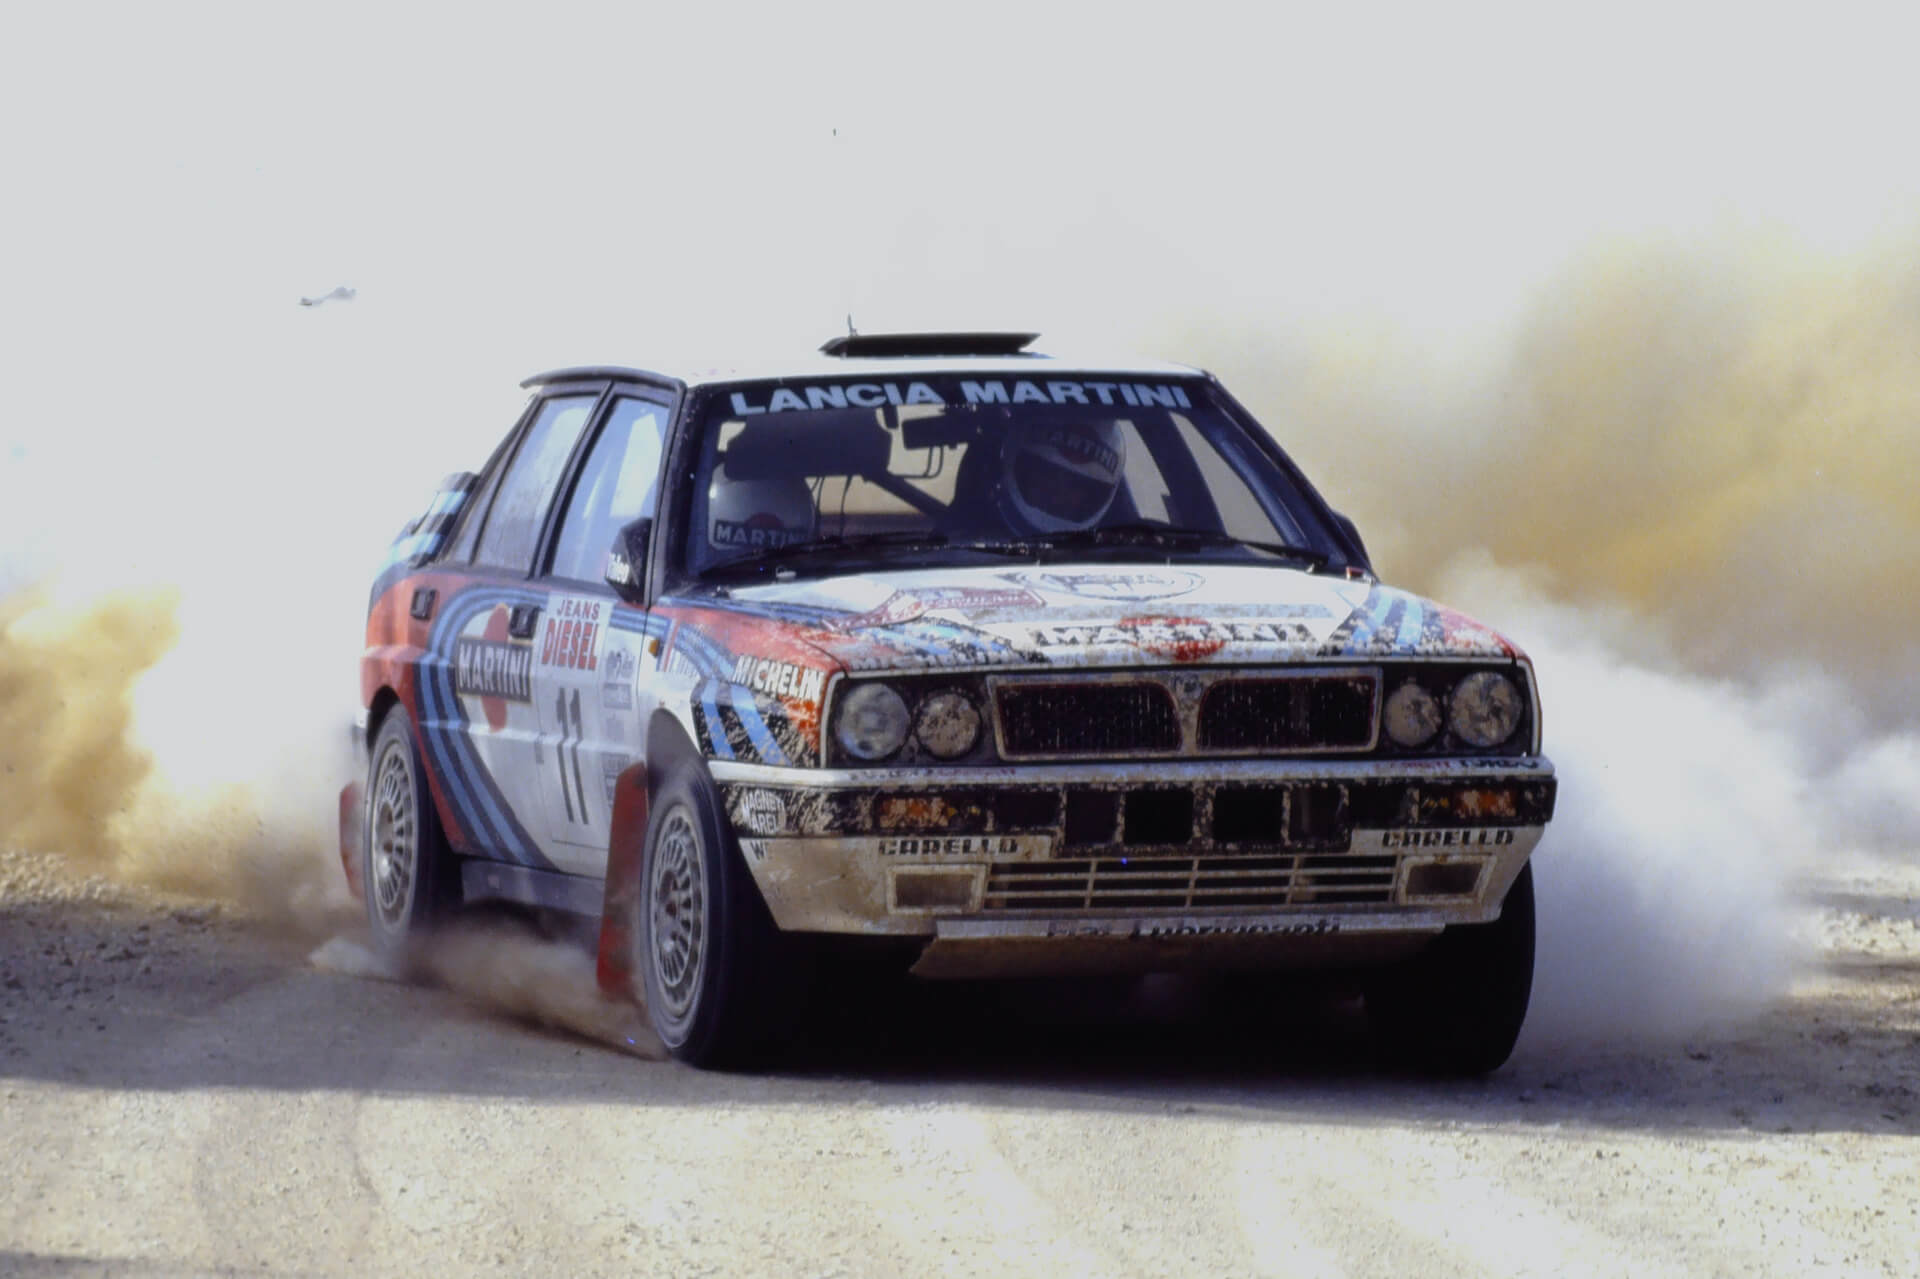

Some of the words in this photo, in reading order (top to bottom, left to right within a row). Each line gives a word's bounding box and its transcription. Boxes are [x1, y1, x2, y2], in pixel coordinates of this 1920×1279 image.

[731, 382, 945, 417] LANCIA
[960, 380, 1193, 410] MARTINI
[557, 599, 600, 620] JEANS
[542, 618, 599, 671] DIESEL
[458, 643, 530, 697] MARTINI
[732, 654, 825, 702] MICHELIN
[556, 687, 589, 824] 11
